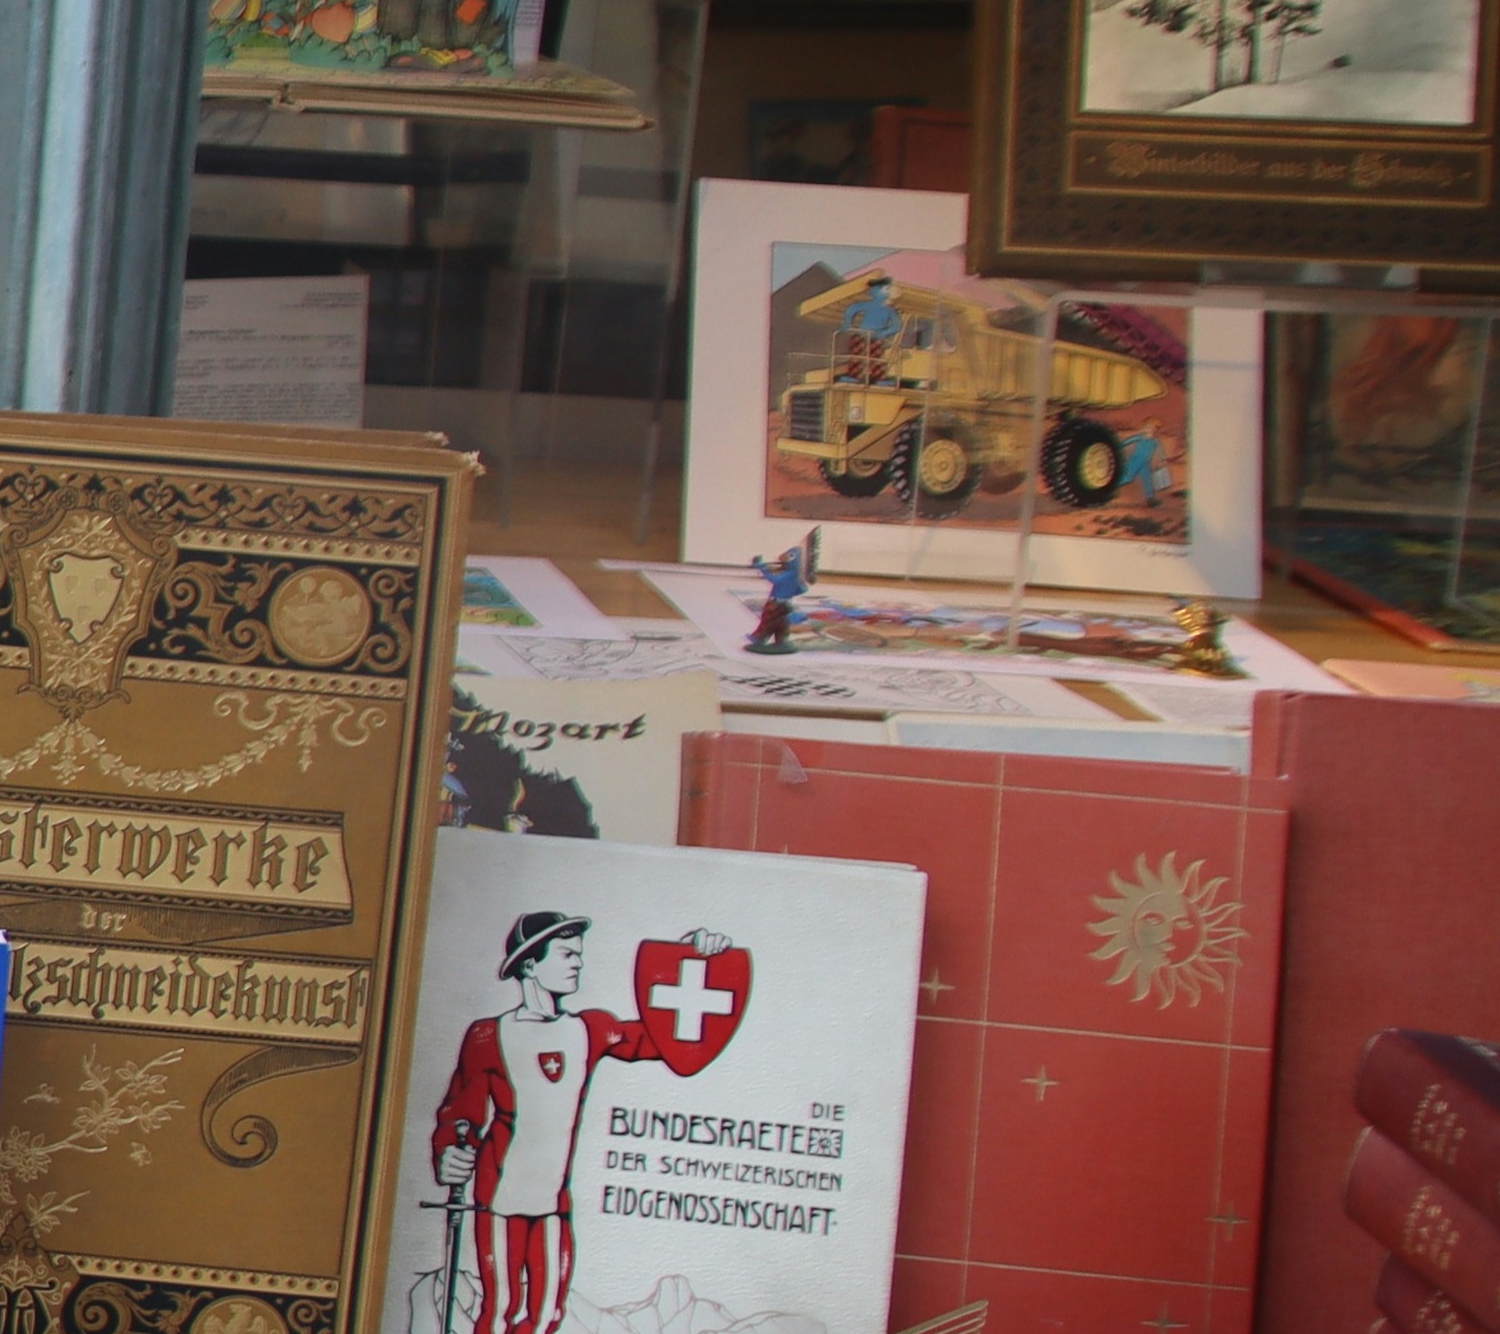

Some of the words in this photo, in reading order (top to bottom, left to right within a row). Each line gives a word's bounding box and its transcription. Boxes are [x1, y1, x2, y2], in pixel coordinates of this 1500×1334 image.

[451, 704, 648, 750] Mozart
[77, 903, 127, 935] der
[8, 941, 367, 1030] lzschneidekunst
[609, 1106, 807, 1156] BUNDESRAETE
[811, 1101, 846, 1122] DIE
[605, 1150, 647, 1172] DER
[659, 1155, 842, 1192] SCHWEIZERISCHEN
